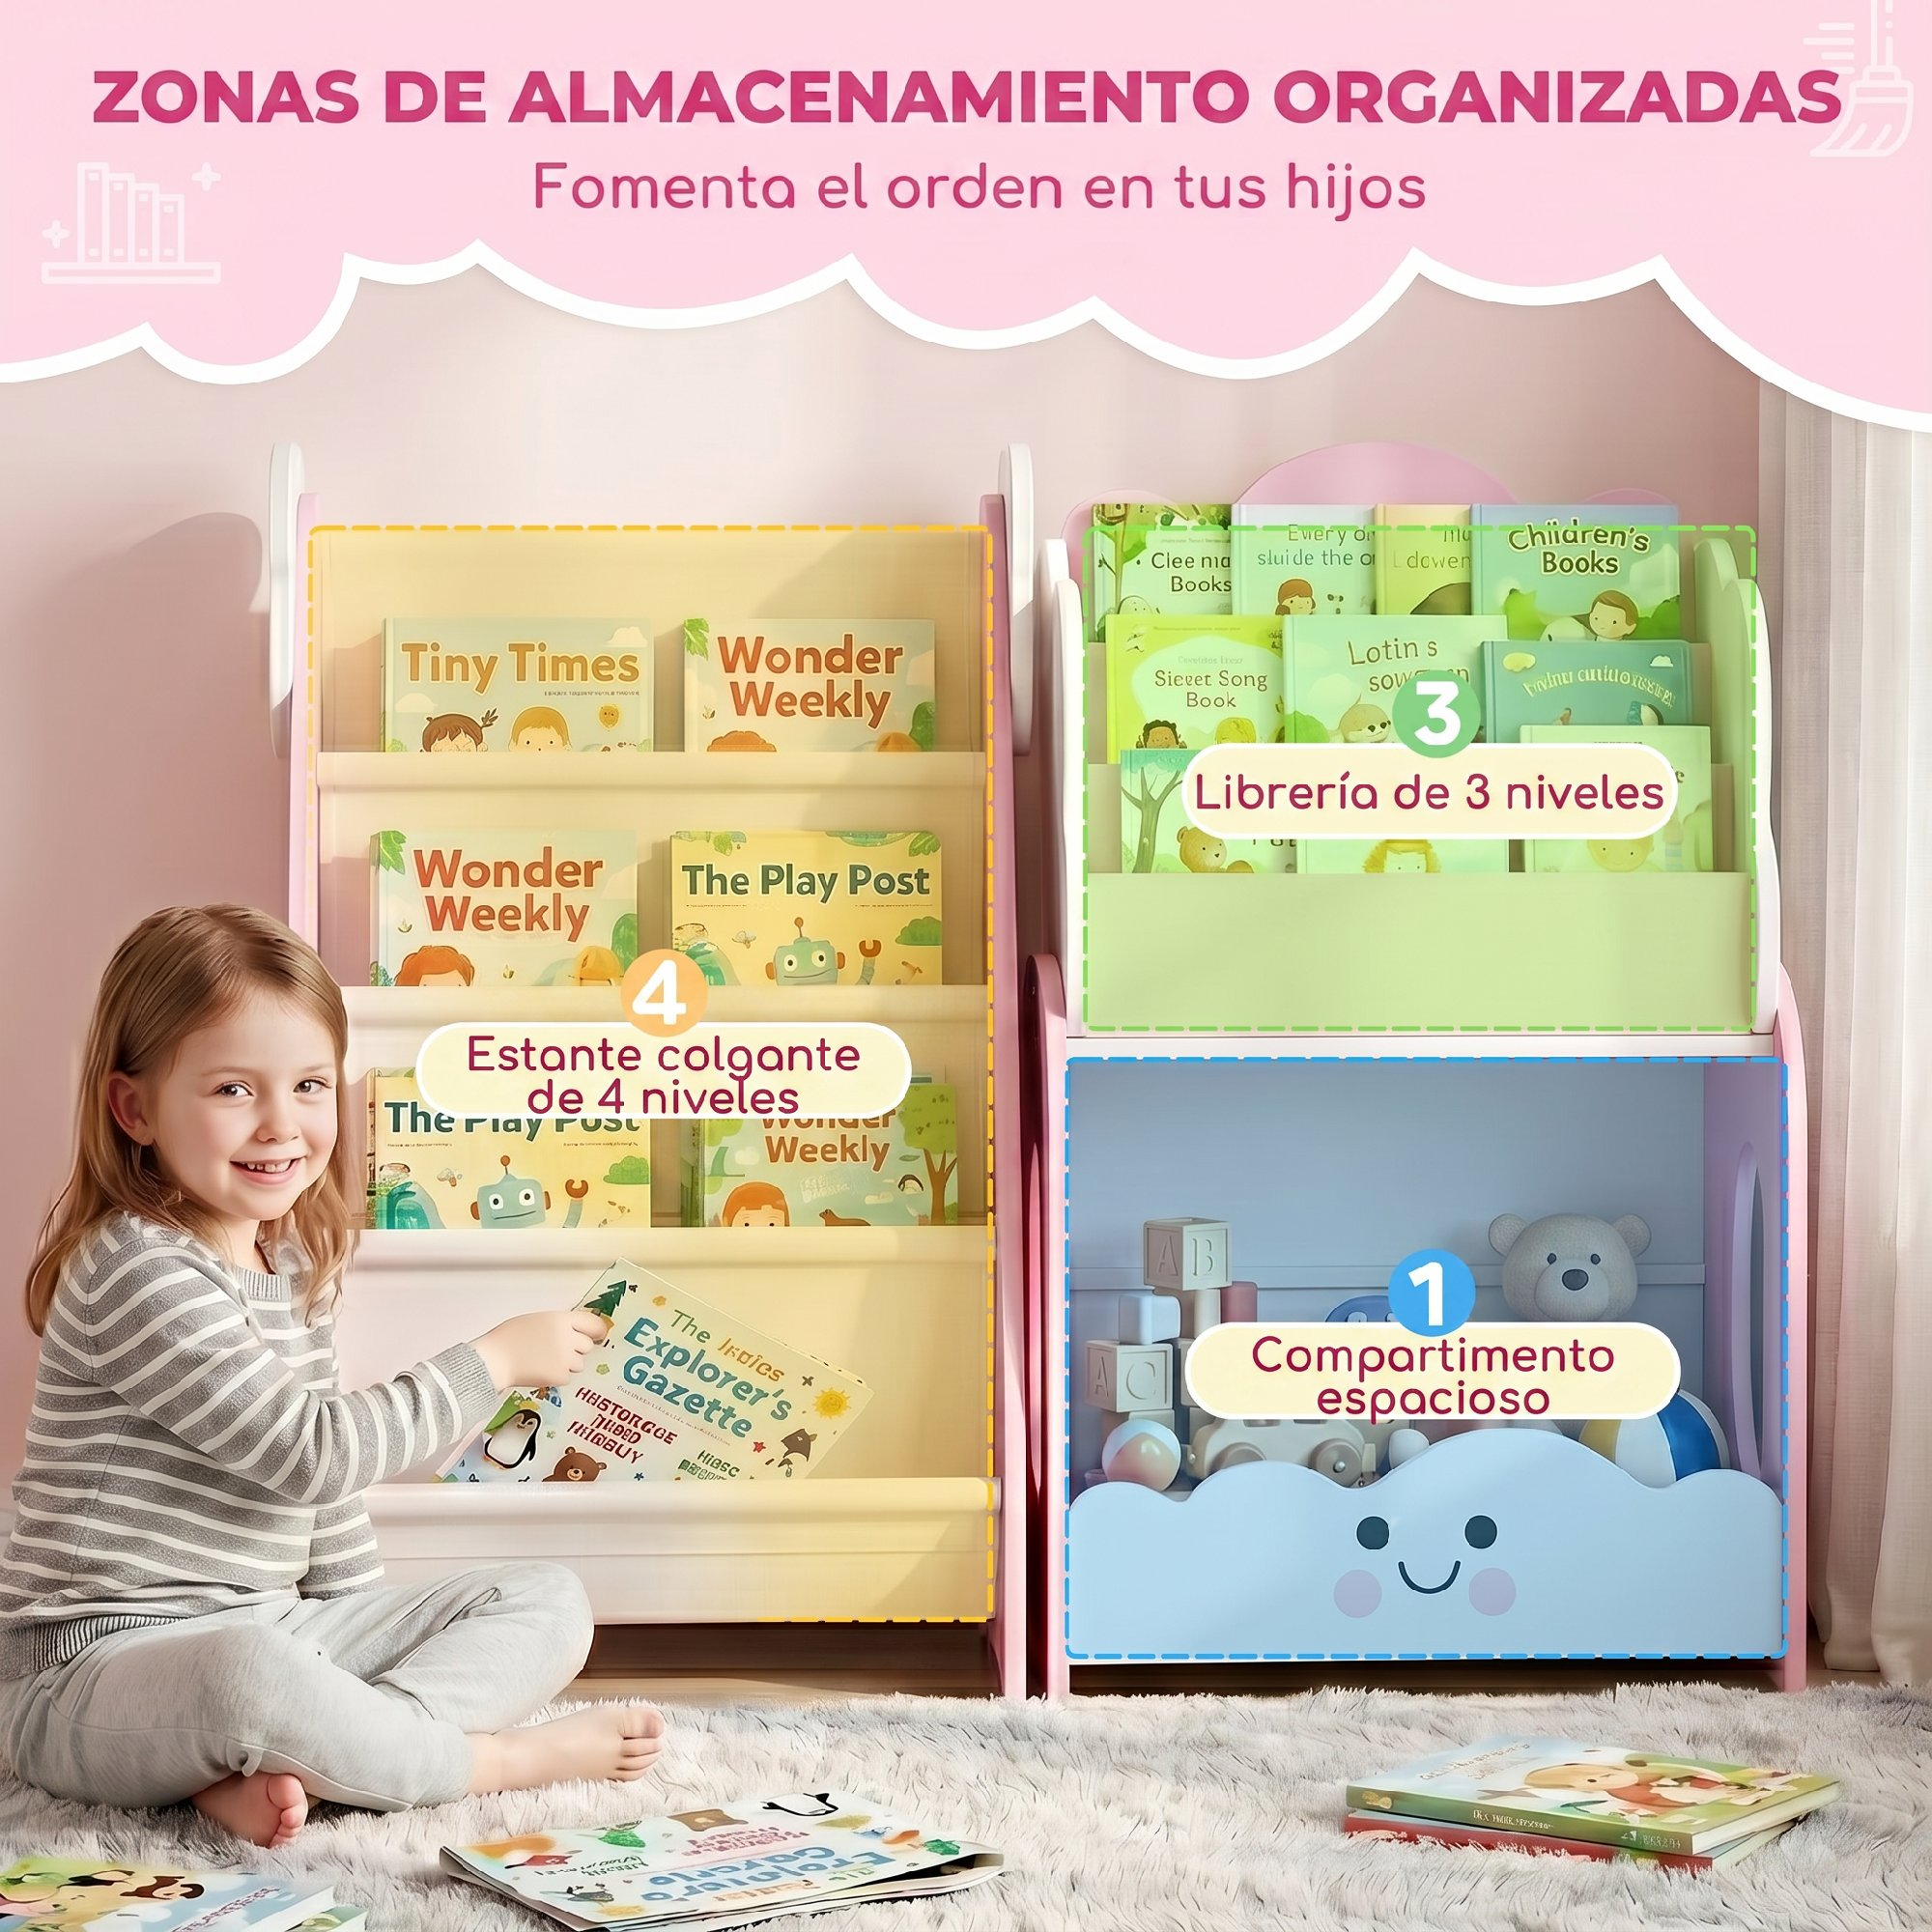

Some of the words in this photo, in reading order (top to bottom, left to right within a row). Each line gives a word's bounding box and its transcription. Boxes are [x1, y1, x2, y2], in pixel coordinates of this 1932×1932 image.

[1321, 549, 1353, 566] the
[1543, 551, 1618, 574] Books
[1171, 575, 1232, 592] Books
[401, 641, 498, 694] Tiny
[508, 641, 639, 682] Times
[717, 634, 903, 674] Wonder
[1186, 691, 1236, 708] Book
[1218, 669, 1267, 692] Song
[729, 679, 891, 728] Weekly
[413, 845, 603, 888] Wonder
[682, 864, 750, 895] The
[761, 864, 838, 903] Play
[849, 864, 930, 895] Post
[425, 893, 590, 942] Weekly
[384, 1101, 455, 1133] The
[765, 1134, 891, 1172] Weekly
[1158, 1236, 1179, 1276] A
[1192, 1236, 1214, 1276] B
[671, 1309, 711, 1344] The
[623, 1317, 792, 1421] Explorer's
[1094, 1355, 1110, 1398] A
[623, 1355, 753, 1438] Gazette
